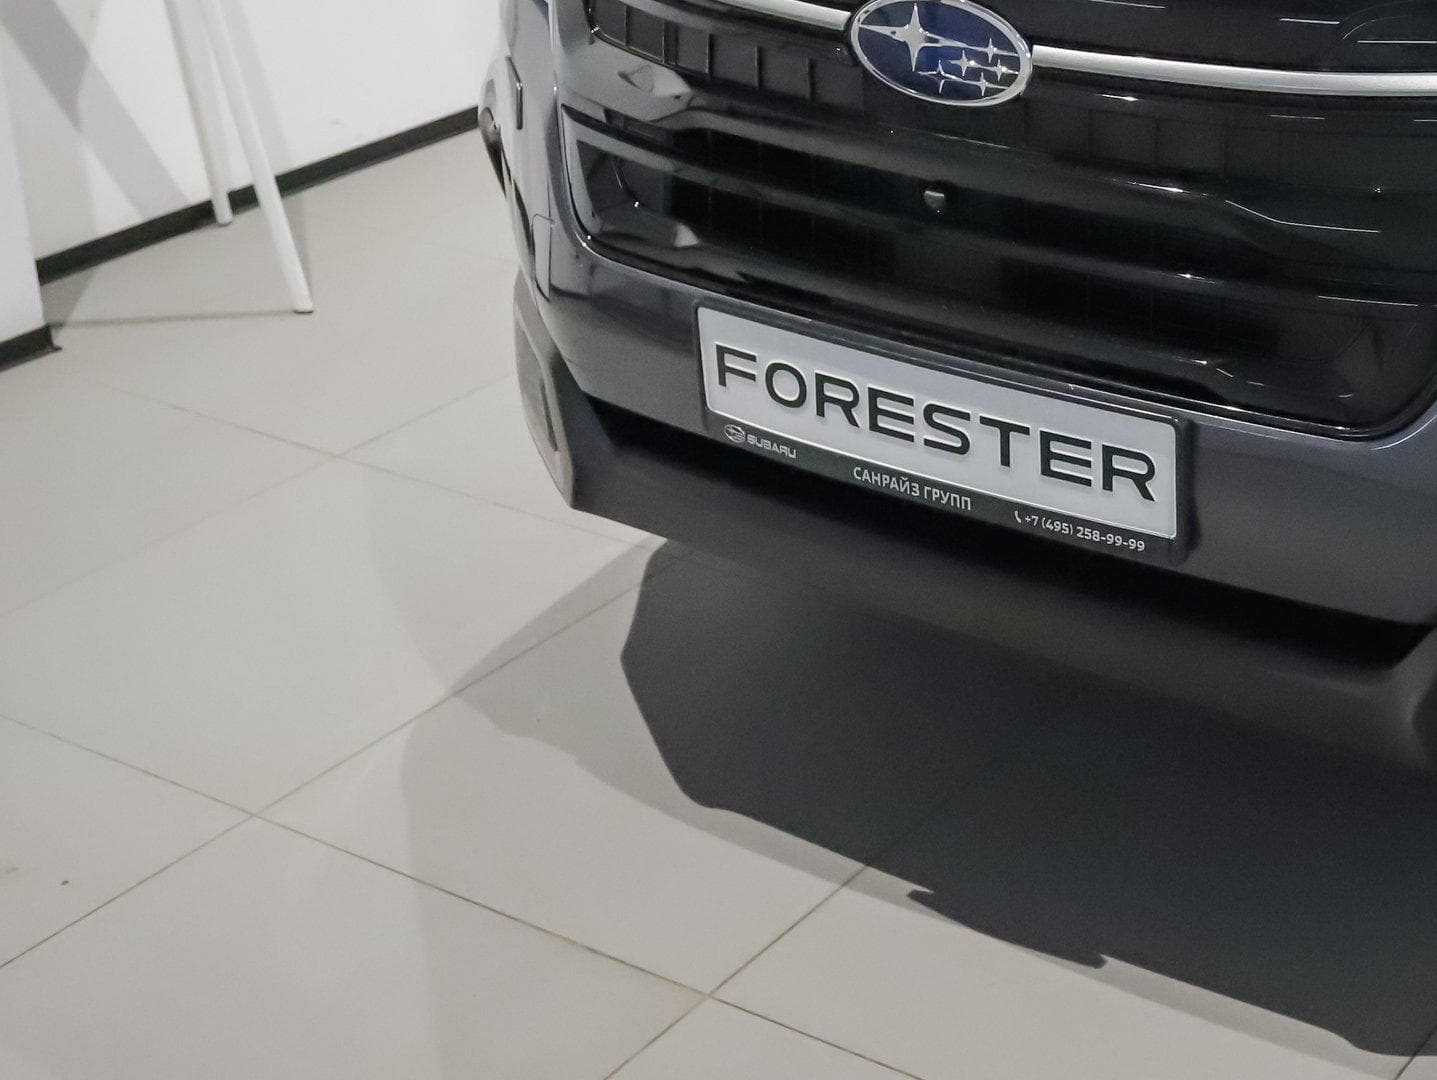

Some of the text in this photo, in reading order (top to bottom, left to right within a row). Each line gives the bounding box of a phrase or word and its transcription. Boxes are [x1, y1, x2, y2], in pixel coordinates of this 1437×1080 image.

[716, 343, 1156, 503] FORESTER
[746, 434, 798, 460] SUBARU
[853, 466, 972, 511] САНРАЙЗ ГРУПП
[1024, 515, 1146, 552] +7 (495) 258-99-99
